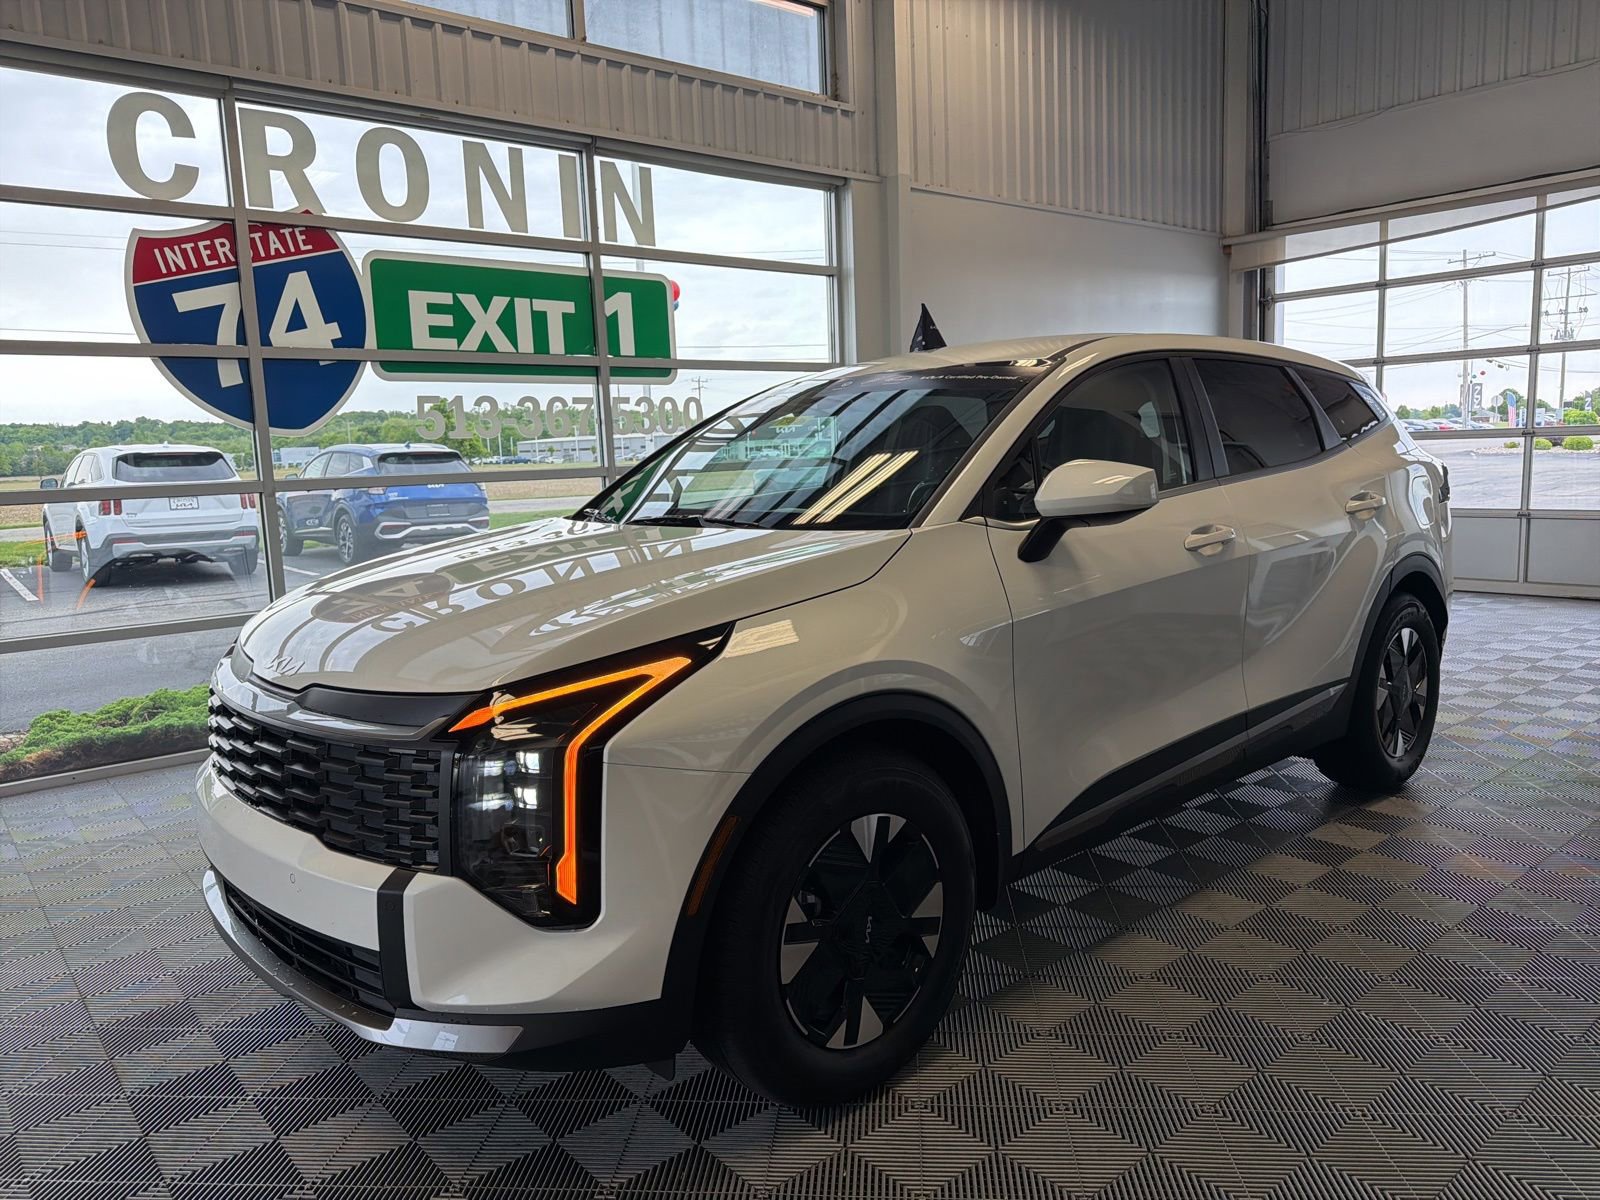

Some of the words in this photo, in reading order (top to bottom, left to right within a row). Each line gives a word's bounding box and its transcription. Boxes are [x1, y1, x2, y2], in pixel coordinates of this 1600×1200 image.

[106, 91, 656, 247] CRONIN
[153, 226, 313, 274] INTERTATE
[171, 270, 343, 389] 74
[407, 289, 576, 355] EXIT
[603, 291, 636, 357] 1
